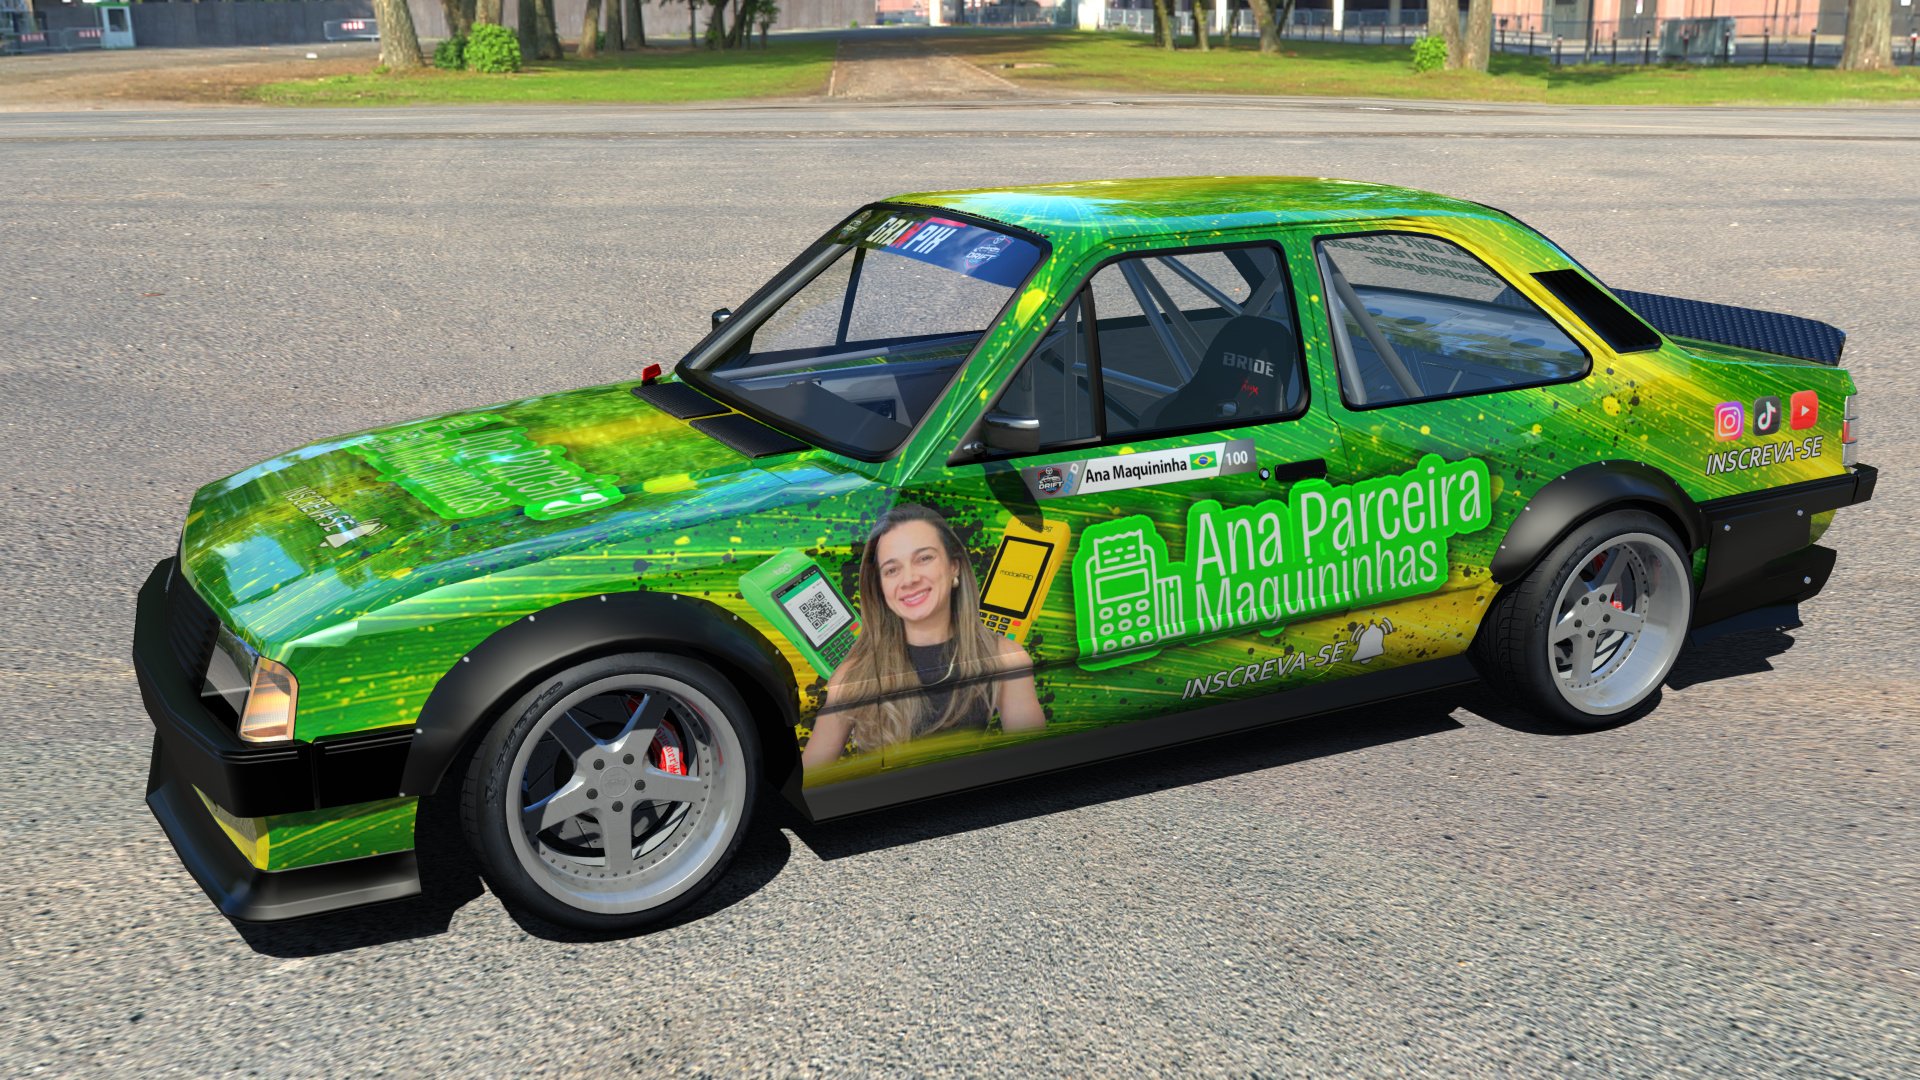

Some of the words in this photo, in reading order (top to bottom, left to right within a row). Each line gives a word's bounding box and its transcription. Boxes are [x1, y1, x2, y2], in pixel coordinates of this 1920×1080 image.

[965, 252, 997, 261] DRIFT
[1223, 352, 1274, 377] BRIDE
[1085, 469, 1110, 483] Ana
[1112, 457, 1187, 480] Maquininha
[1226, 450, 1248, 466] 100
[1705, 436, 1824, 475] INSCREVA-SE
[1038, 481, 1064, 490] DRIFT
[281, 485, 355, 532] INSCREVA-SE
[1196, 511, 1284, 581] Ana
[1300, 466, 1481, 557] Parceira
[1195, 540, 1438, 632] Maquininhas
[1182, 641, 1347, 700] INSCREVA-SE
